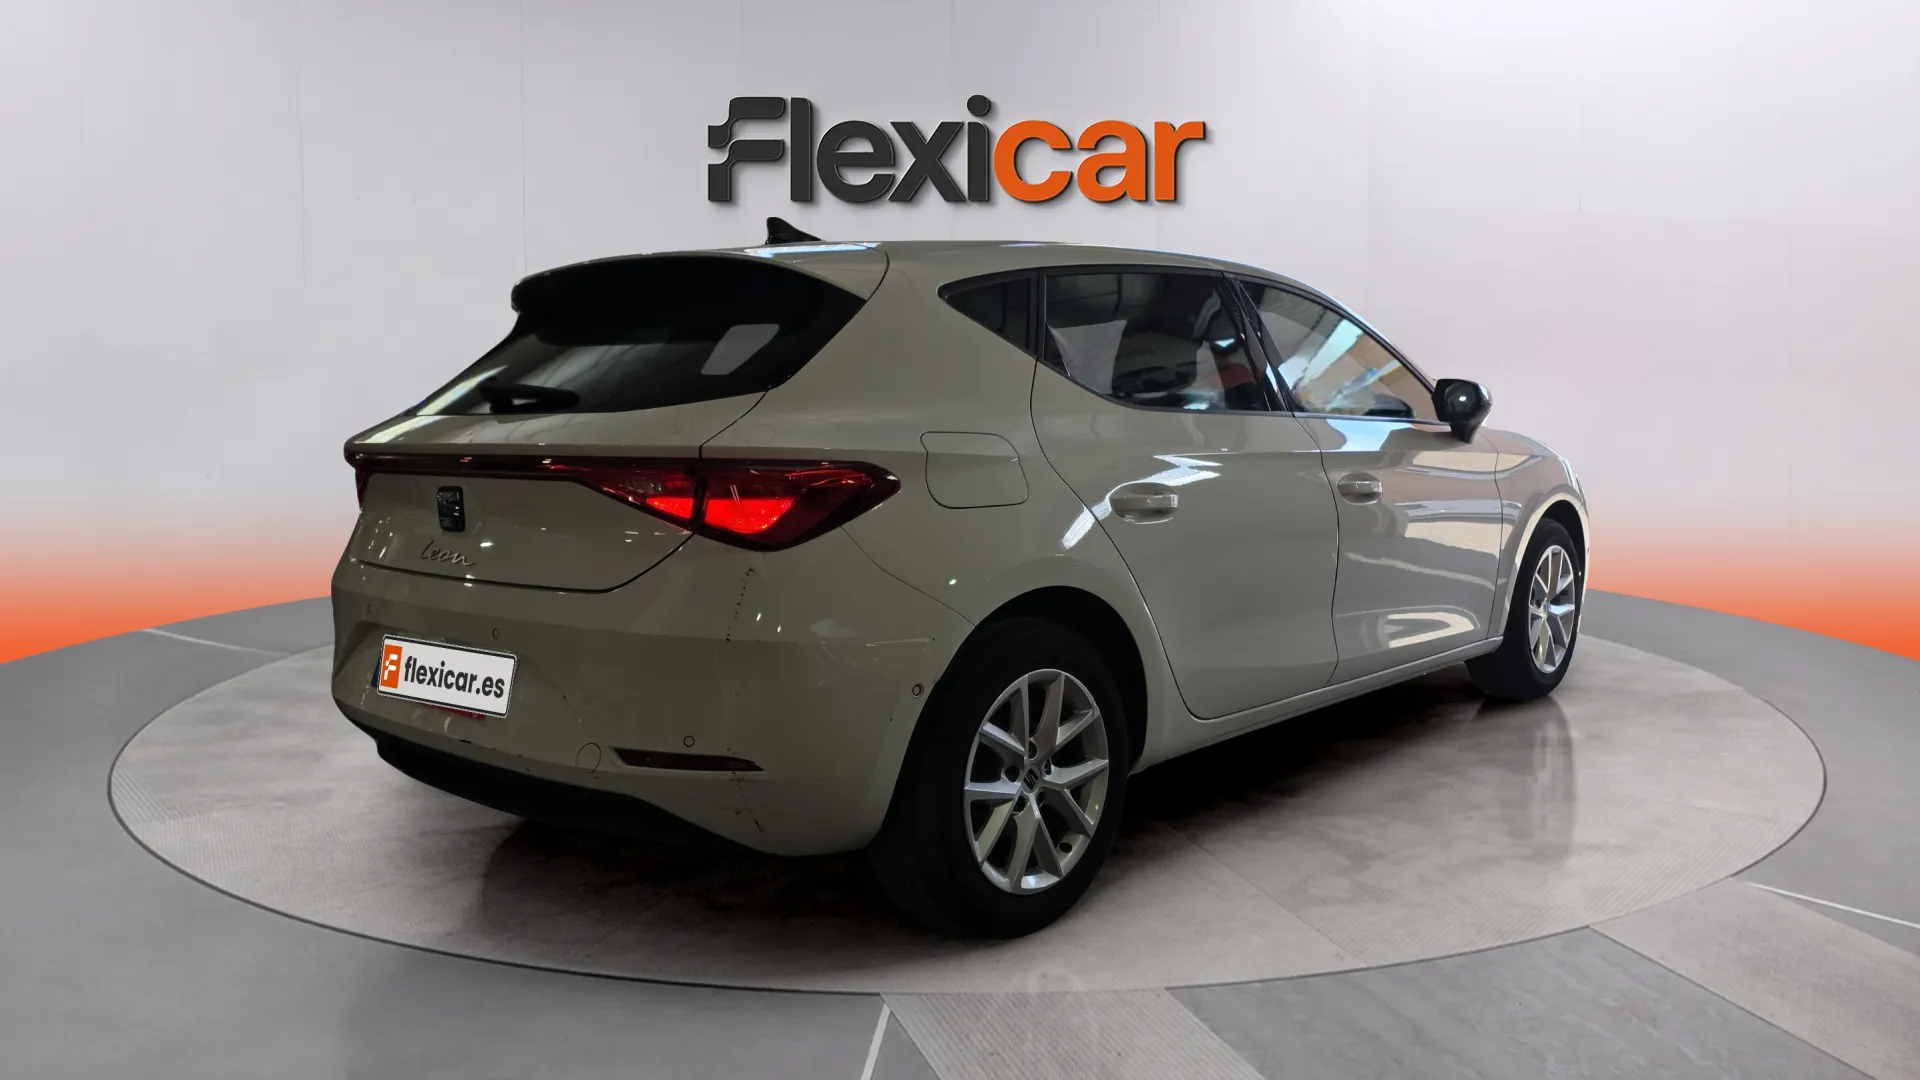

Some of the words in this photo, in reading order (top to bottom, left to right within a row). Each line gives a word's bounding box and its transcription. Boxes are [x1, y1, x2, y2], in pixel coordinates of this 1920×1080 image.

[708, 95, 1206, 202] Flexicar
[421, 540, 475, 567] Leon
[404, 656, 505, 698] flexicar.es
